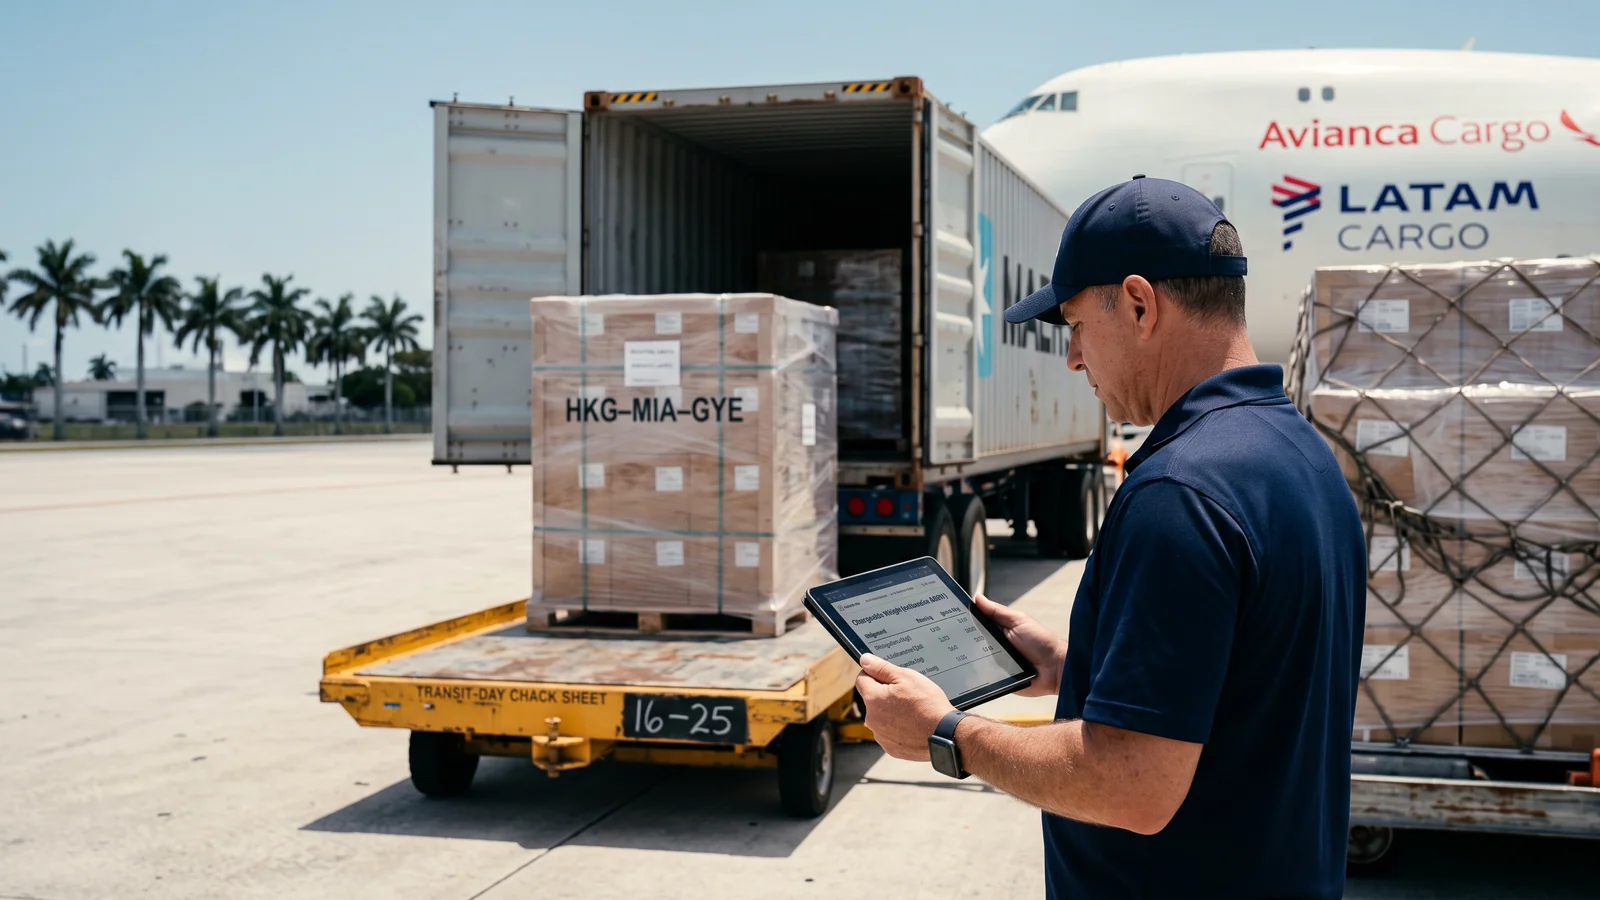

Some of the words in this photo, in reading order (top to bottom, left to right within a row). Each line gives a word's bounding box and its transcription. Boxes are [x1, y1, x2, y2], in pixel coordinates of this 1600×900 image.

[1259, 119, 1419, 150] Avianca
[1430, 115, 1551, 153] Cargo
[1339, 181, 1540, 214] LATAM
[1337, 222, 1490, 252] CARGO
[416, 685, 506, 701] TRANSIT-DAY
[509, 688, 558, 704] CHACK
[562, 690, 607, 705] SHEET
